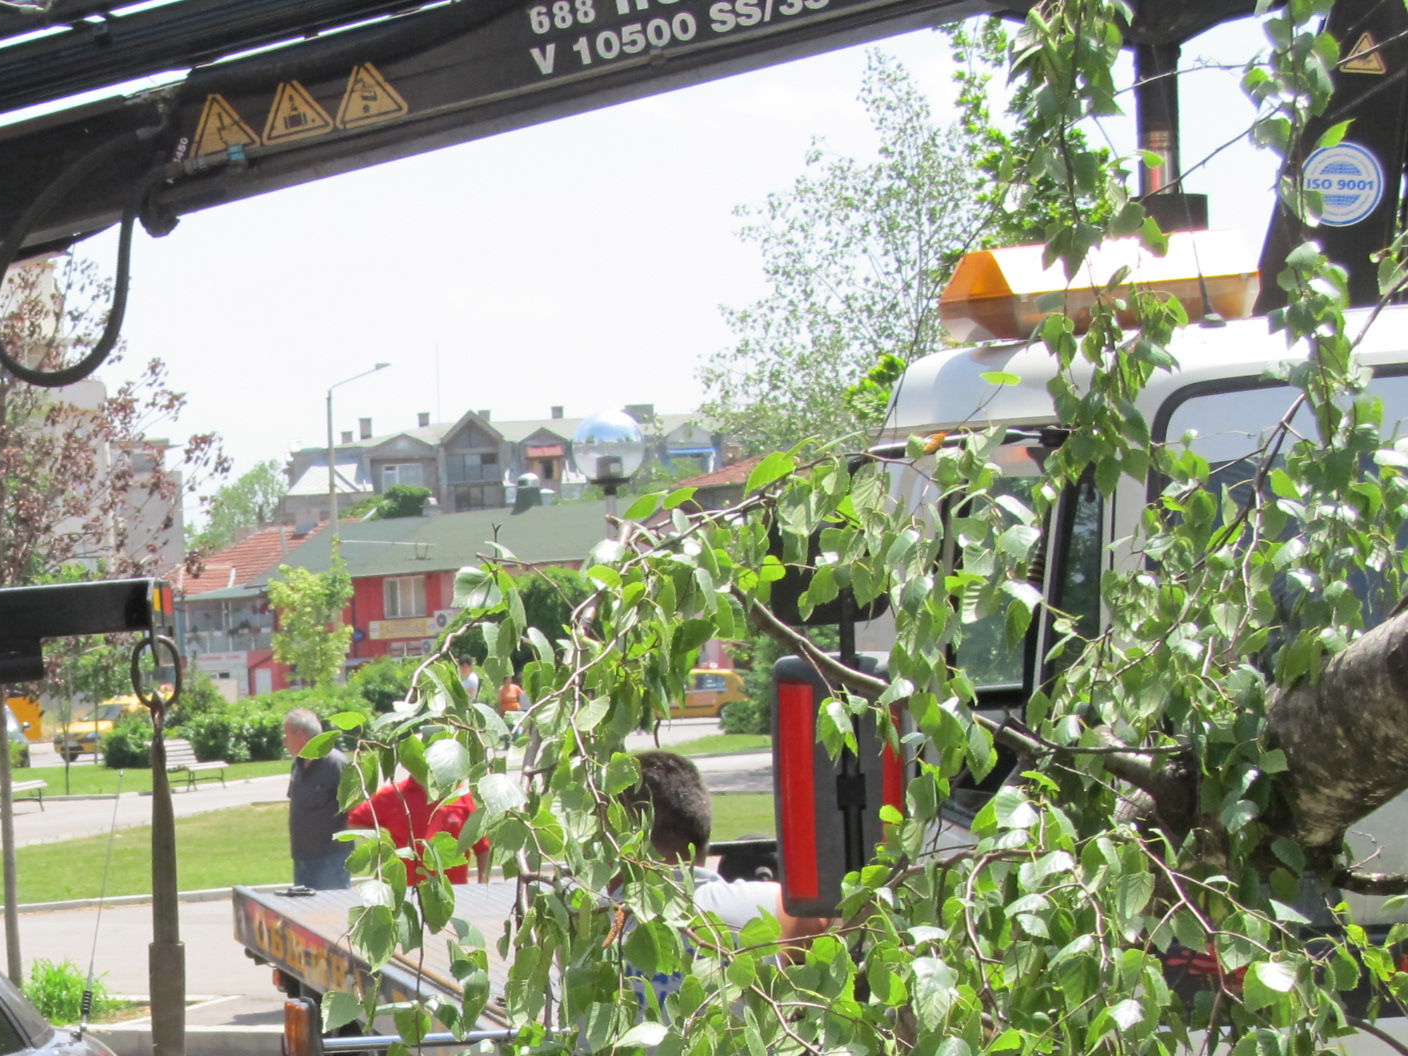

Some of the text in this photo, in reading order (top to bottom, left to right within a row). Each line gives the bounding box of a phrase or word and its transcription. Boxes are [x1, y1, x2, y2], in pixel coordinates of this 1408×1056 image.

[530, 0, 596, 34] 688
[529, 43, 556, 75] V
[572, 12, 697, 65] 10500
[1307, 178, 1374, 191] ISO 9001
